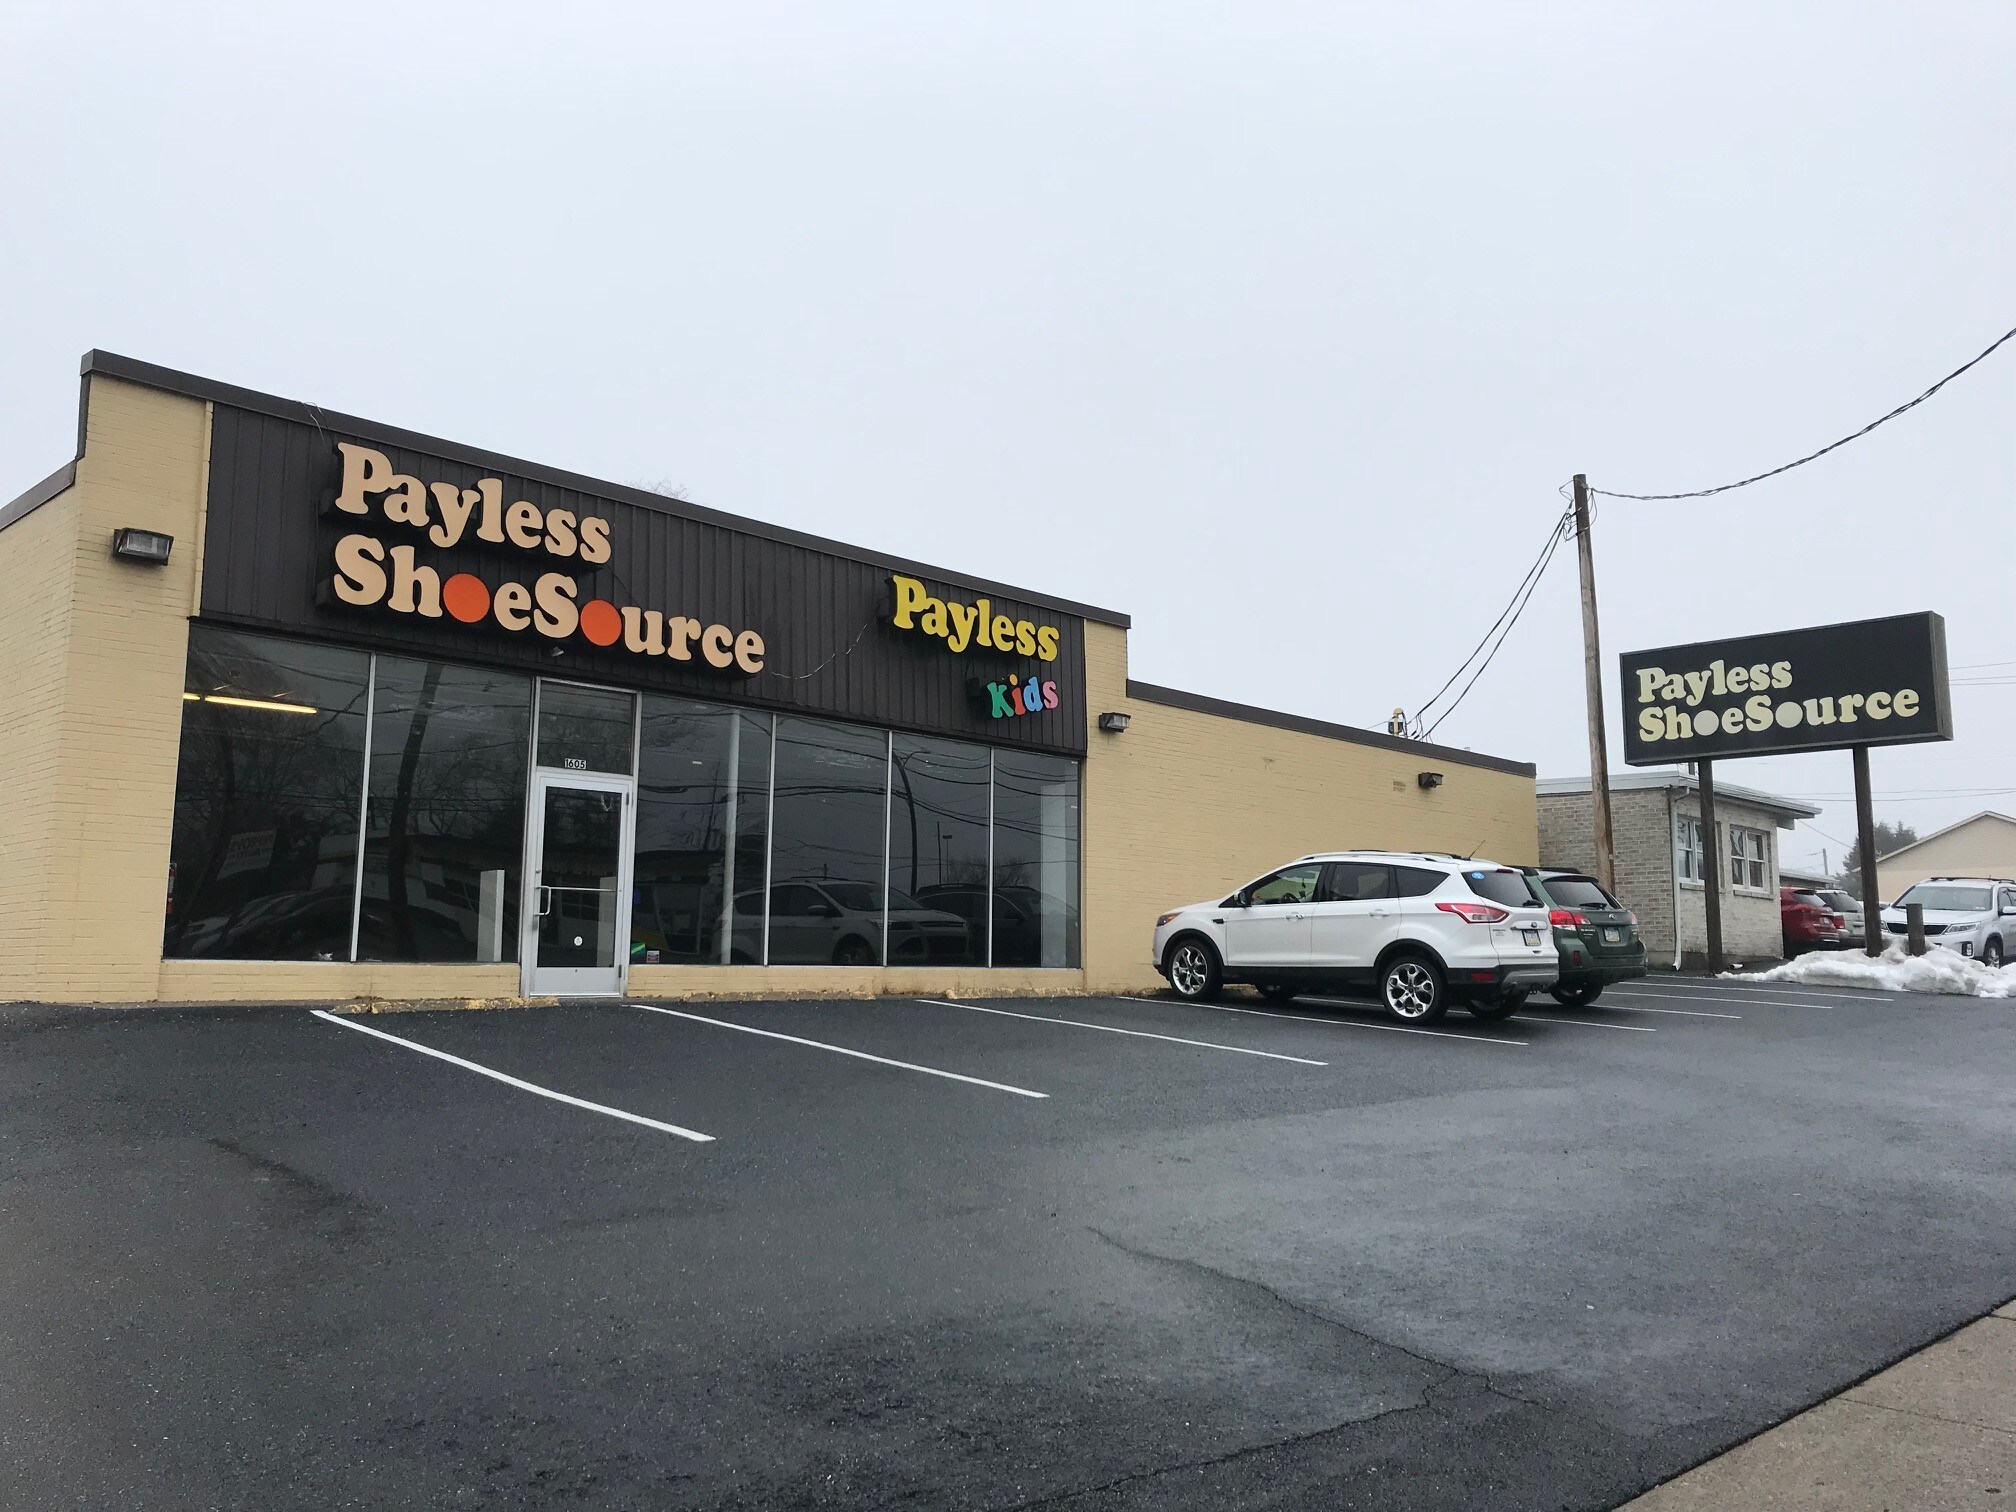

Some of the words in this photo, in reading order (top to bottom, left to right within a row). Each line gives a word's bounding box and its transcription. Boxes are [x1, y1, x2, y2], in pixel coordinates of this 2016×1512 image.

[335, 442, 612, 564] Payless
[333, 533, 766, 674] ShoeSource
[893, 574, 1060, 662] Payless
[987, 673, 1059, 719] Kids
[1636, 659, 1793, 707] Payless
[1637, 688, 1920, 742] ShoeSource
[565, 758, 587, 770] 1605
